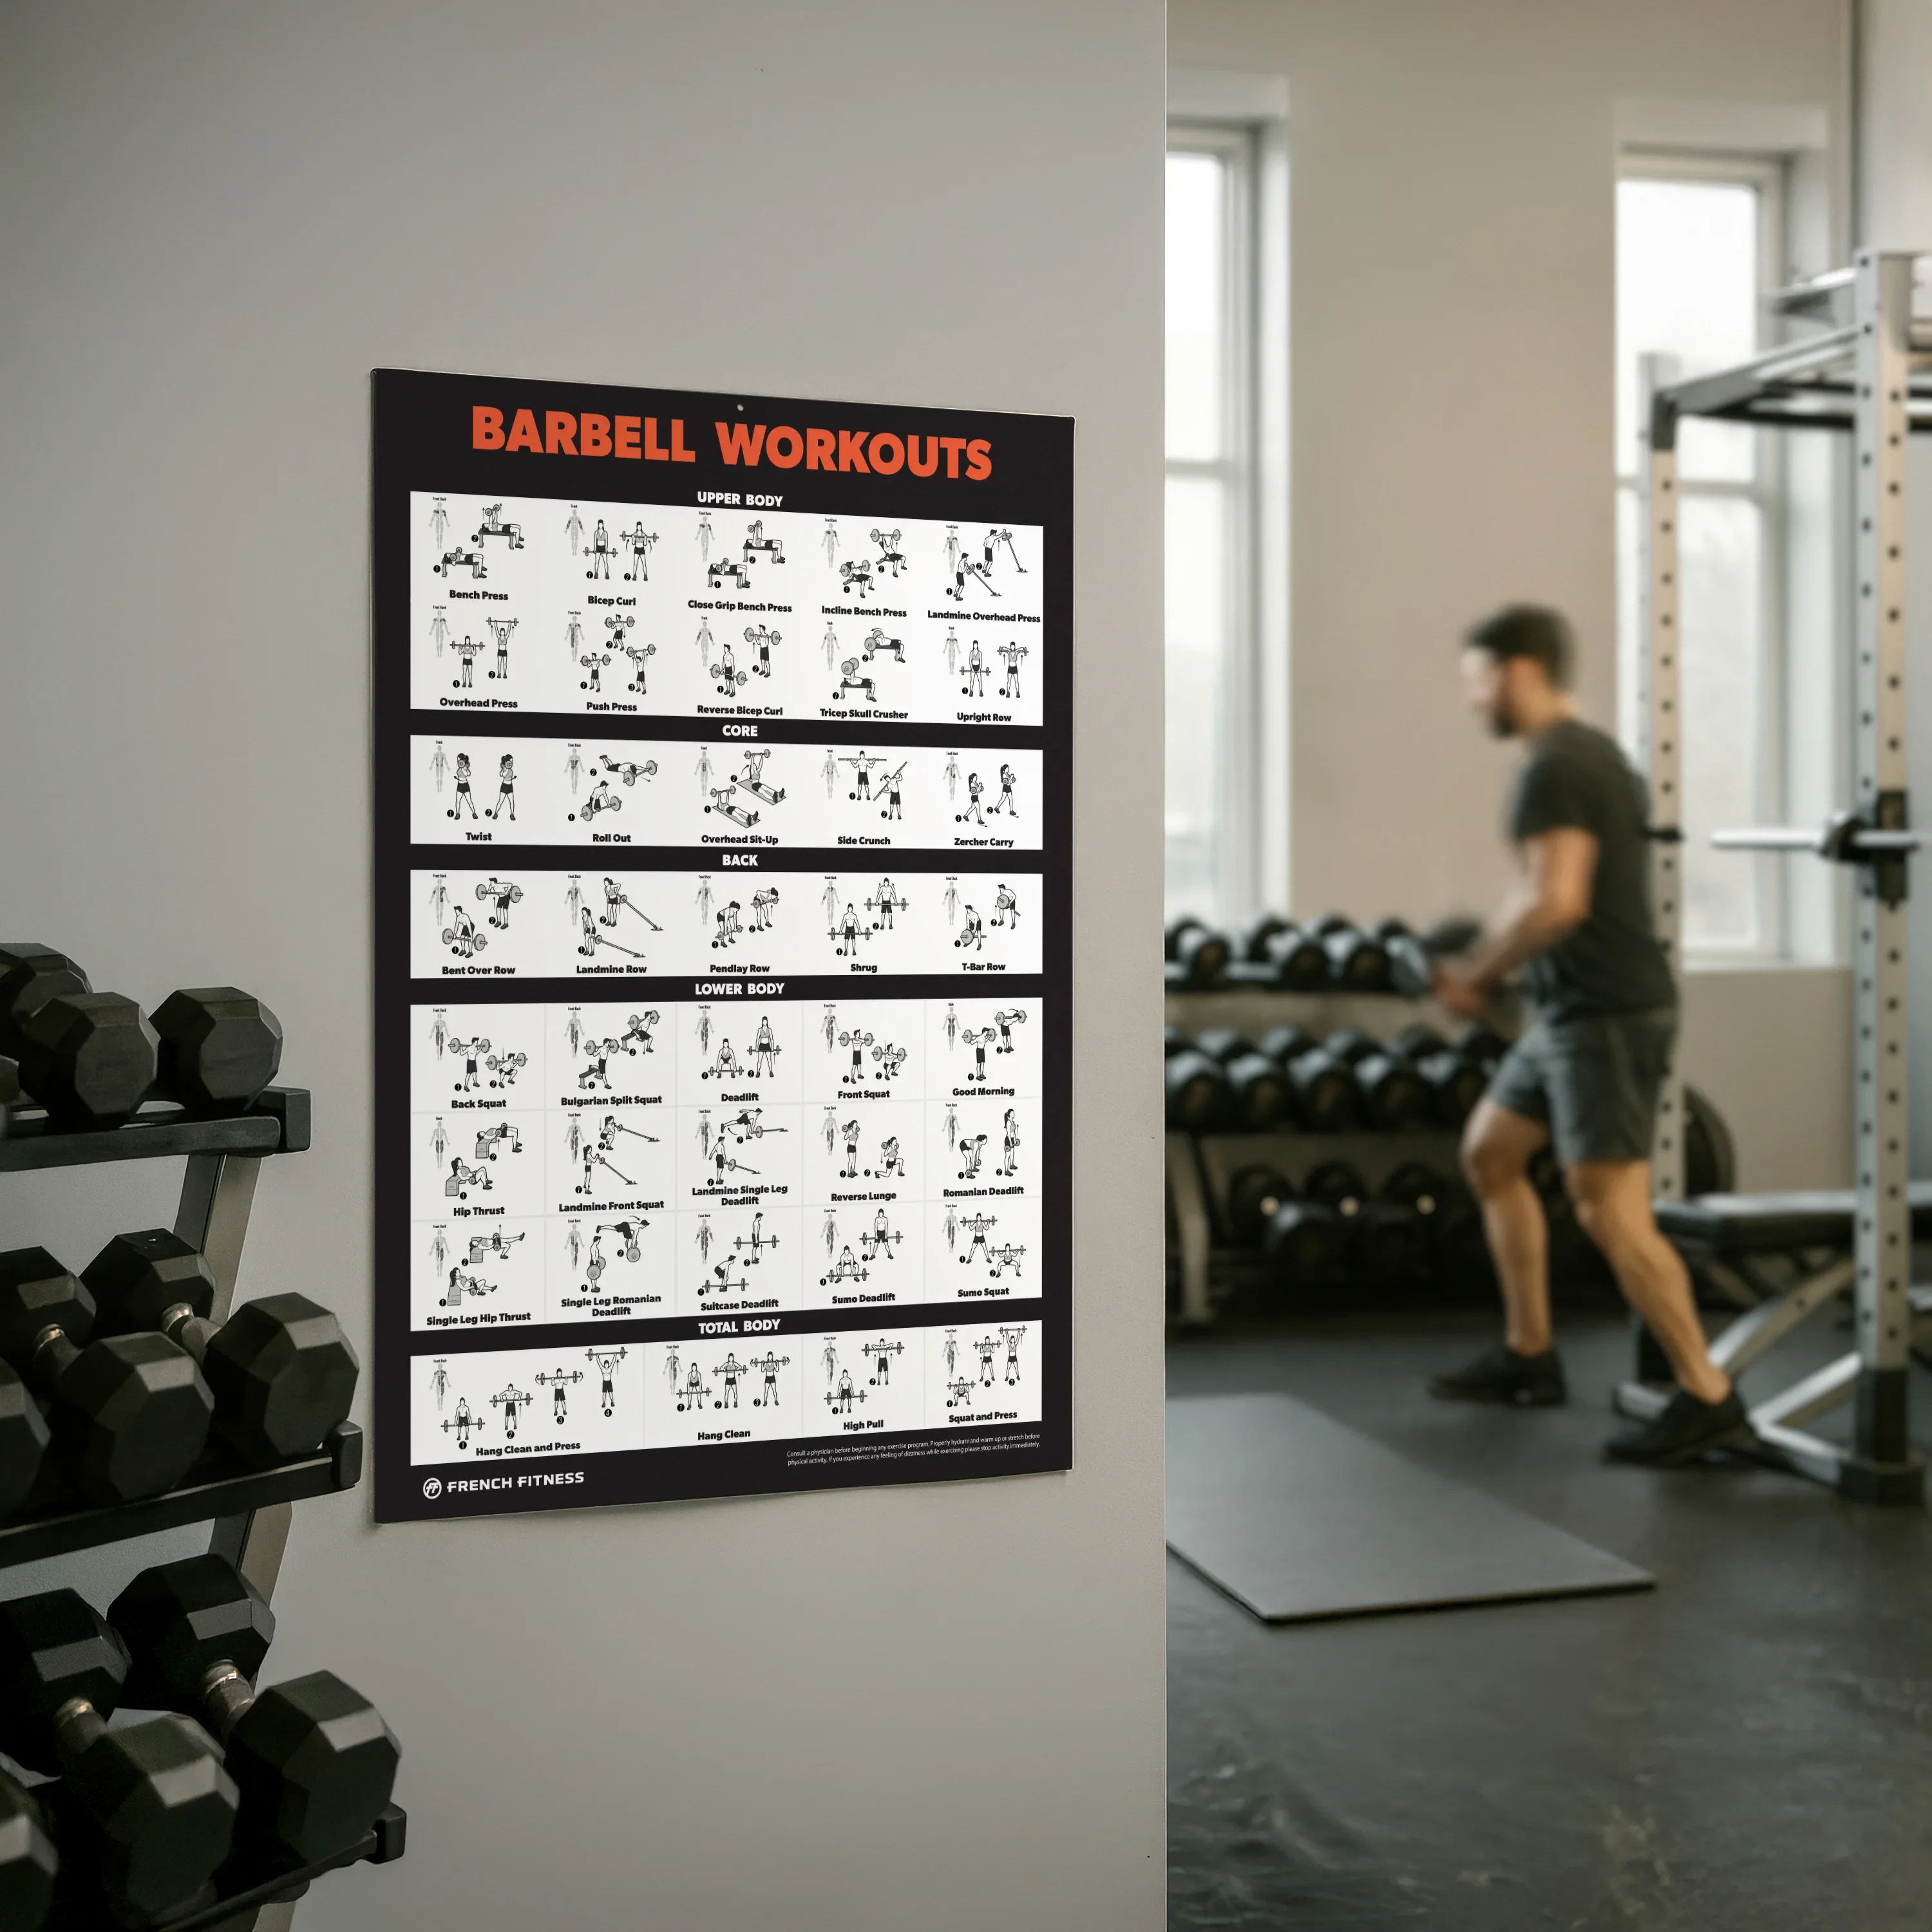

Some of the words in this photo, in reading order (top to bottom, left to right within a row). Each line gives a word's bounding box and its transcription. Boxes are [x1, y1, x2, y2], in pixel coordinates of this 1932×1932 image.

[472, 405, 696, 462] BARBELL
[715, 422, 992, 481] WORKOUTS
[697, 491, 741, 505] UPPER
[746, 493, 784, 507] BODY
[449, 589, 480, 600] Bench
[482, 591, 509, 601] Press
[587, 595, 615, 607] Bicep
[616, 596, 636, 606] Curl
[688, 600, 714, 609] Close
[715, 601, 736, 612] Grip
[737, 601, 766, 612] Bench
[767, 603, 792, 612] Press
[822, 605, 853, 615] Incline
[853, 607, 882, 616] Bench
[883, 608, 907, 618] Press
[927, 610, 972, 620] Landmine
[972, 612, 1016, 622] Overhead
[1018, 614, 1041, 623] Press
[439, 697, 489, 708] Overhead
[491, 699, 518, 708] Press
[586, 701, 610, 711] Push
[611, 702, 638, 712] Press
[697, 705, 735, 714] Reverse
[736, 705, 762, 717] Bicep
[763, 706, 783, 715] Curl
[819, 708, 848, 719] Tricep
[849, 709, 872, 718] Skull
[873, 710, 909, 719] Crusher
[956, 712, 992, 723] Upright
[992, 713, 1012, 722] Row
[722, 724, 758, 737] CORE
[465, 831, 493, 841] Twist
[592, 833, 611, 842] Roll
[612, 833, 631, 842] Out
[701, 835, 748, 844] Overhead
[749, 835, 779, 846] Sit-Up
[837, 835, 858, 845] Side
[858, 836, 891, 845] Crunch
[954, 837, 989, 846] Zercher
[989, 838, 1014, 848] Carry
[722, 854, 759, 866] BACK
[442, 966, 466, 975] Bent
[467, 965, 493, 975] Over
[494, 965, 516, 974] Row
[576, 964, 625, 974] Landmine
[626, 965, 647, 974] Row
[710, 964, 748, 974] Pendlay
[750, 964, 770, 972] Row
[850, 963, 878, 974] Shrug
[961, 963, 986, 971] T-Bar
[987, 962, 1006, 971] Row
[695, 983, 743, 995] LOWER
[747, 983, 785, 994] BODY
[721, 1092, 759, 1102] Deadlift
[838, 1090, 863, 1099] Front
[864, 1090, 891, 1100] Squat
[952, 1087, 976, 1096] Good
[978, 1086, 1015, 1097] Morning
[451, 1099, 476, 1109] Back
[477, 1099, 507, 1110] Squat
[561, 1096, 609, 1108] Bulgarian
[610, 1095, 633, 1106] Split
[634, 1095, 663, 1106] Squat
[692, 1186, 739, 1196] Landmine
[740, 1185, 770, 1195] Single
[771, 1184, 788, 1195] Leg
[943, 1187, 988, 1197] Romanian
[989, 1186, 1025, 1195] Deadlift
[721, 1196, 759, 1206] Deadlift
[831, 1193, 867, 1202] Reverse
[869, 1191, 897, 1202] Lunge
[558, 1202, 607, 1212] Landmine
[609, 1201, 635, 1211] Front
[636, 1200, 665, 1211] Squat
[453, 1207, 471, 1218] Hip
[472, 1206, 505, 1216] Thrust
[957, 1289, 983, 1298] Sumo
[983, 1287, 1010, 1298] Squat
[561, 1298, 592, 1308] Single
[593, 1297, 611, 1307] Leg
[612, 1294, 661, 1305] Romanian
[831, 1296, 858, 1304] Sumo
[859, 1293, 896, 1303] Deadlift
[700, 1302, 740, 1311] Suitcase
[741, 1298, 779, 1309] Deadlift
[592, 1306, 631, 1317] Deadlift
[426, 1316, 459, 1327] Single
[460, 1315, 478, 1325] Leg
[480, 1313, 498, 1324] Hip
[498, 1312, 531, 1322] Thrust
[698, 1321, 739, 1334] TOTAL
[743, 1318, 781, 1332] BODY
[949, 1414, 975, 1425] Squat
[976, 1412, 993, 1421] and
[994, 1411, 1018, 1420] Press
[843, 1421, 865, 1432] High
[866, 1419, 884, 1429] Pull
[697, 1432, 723, 1441] Hang
[724, 1430, 751, 1439] Clean
[476, 1447, 503, 1457] Hang
[504, 1445, 533, 1454] Clean
[533, 1443, 553, 1452] and
[554, 1442, 581, 1451] Press
[811, 1448, 834, 1457] physician
[788, 1458, 808, 1466] physical
[446, 1477, 512, 1493] FRENCH
[516, 1472, 584, 1488] FITNESS
